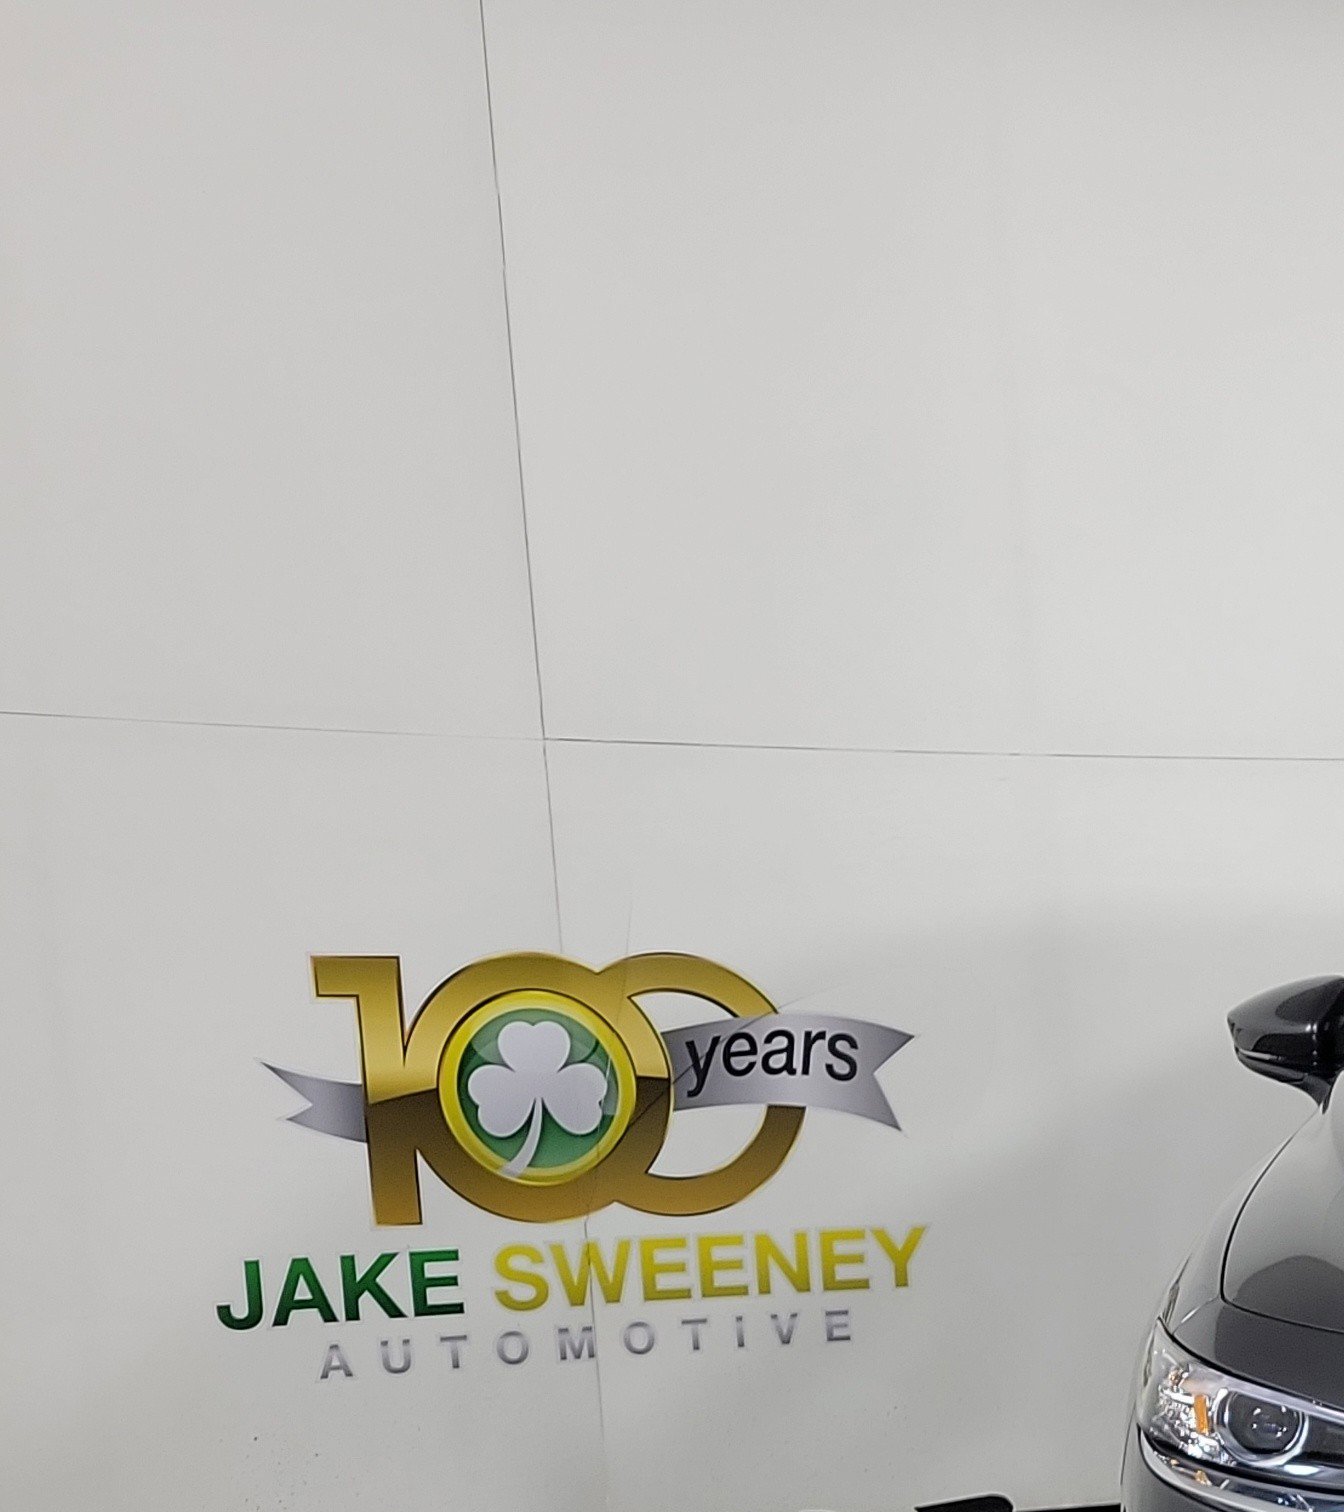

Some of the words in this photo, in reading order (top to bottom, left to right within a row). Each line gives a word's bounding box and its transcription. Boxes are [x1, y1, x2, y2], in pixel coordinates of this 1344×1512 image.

[310, 951, 806, 1227] 100
[685, 1028, 860, 1098] years
[216, 1248, 465, 1331] JAKE
[494, 1225, 928, 1312] SWEENEY
[319, 1308, 852, 1381] AUTOMOTIVE
